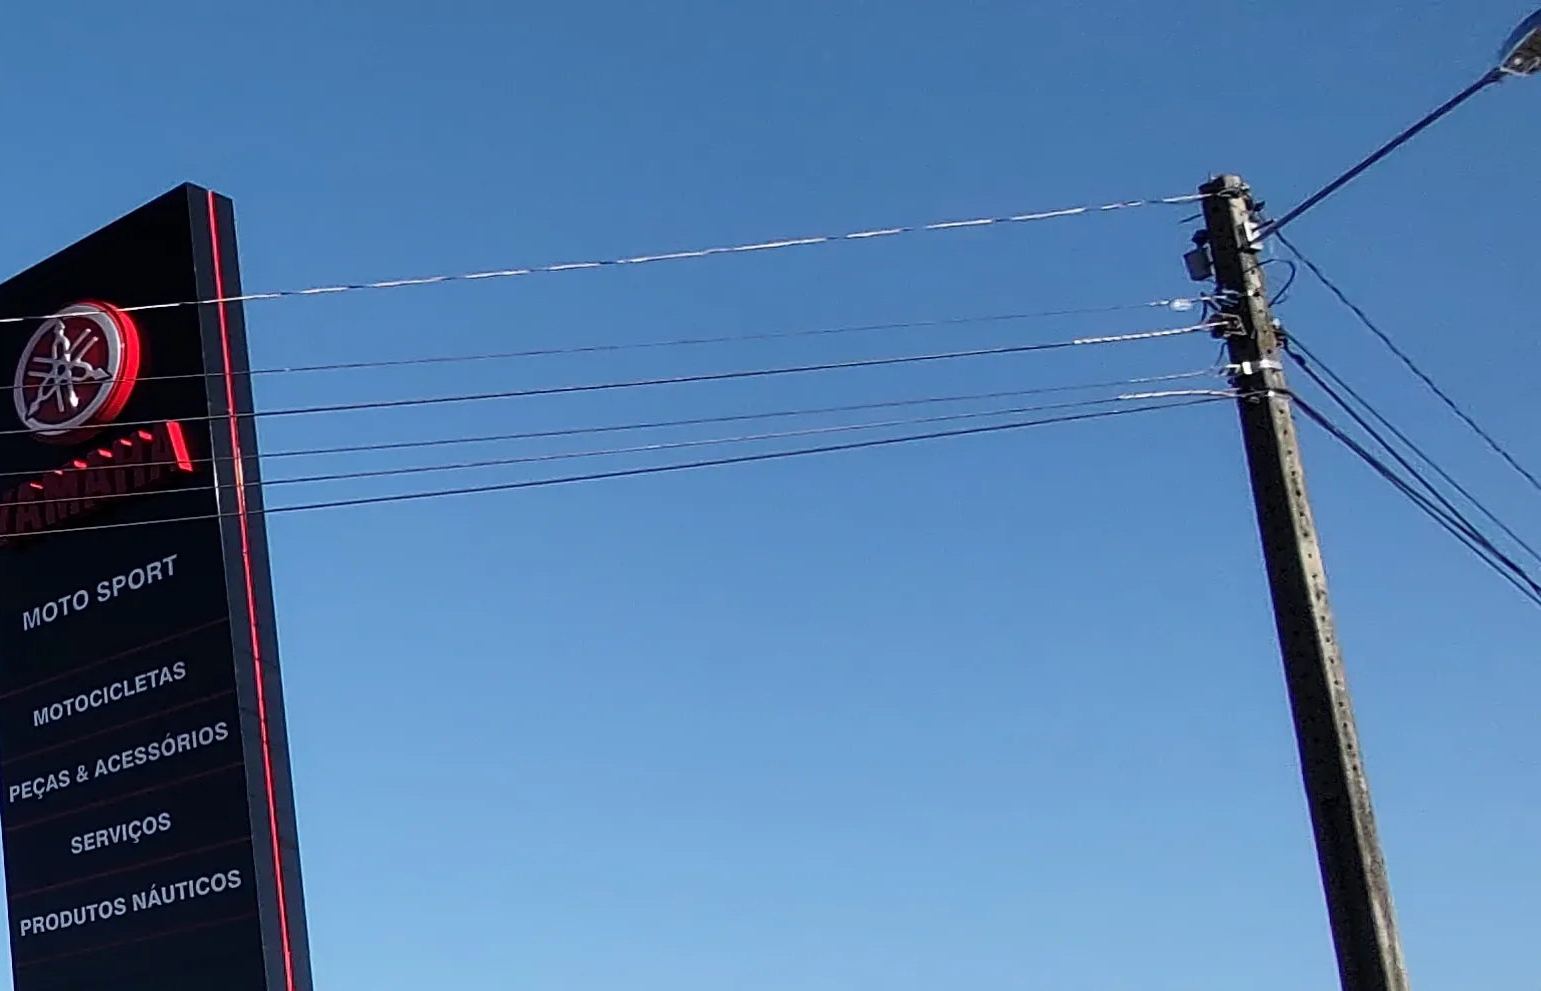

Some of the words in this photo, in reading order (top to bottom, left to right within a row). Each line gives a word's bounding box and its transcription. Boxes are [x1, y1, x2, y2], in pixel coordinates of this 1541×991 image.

[22, 589, 89, 631] MOTO
[97, 554, 177, 602] SPORT
[33, 661, 187, 727] MOTOCICLETAS
[9, 770, 70, 803] PEÇAS
[76, 765, 89, 783] &
[94, 722, 229, 778] ACESSÓRIOS
[71, 812, 172, 854] SERVIÇOS
[20, 897, 126, 936] PRODUTOS
[133, 869, 242, 925] NÁUTICOS
